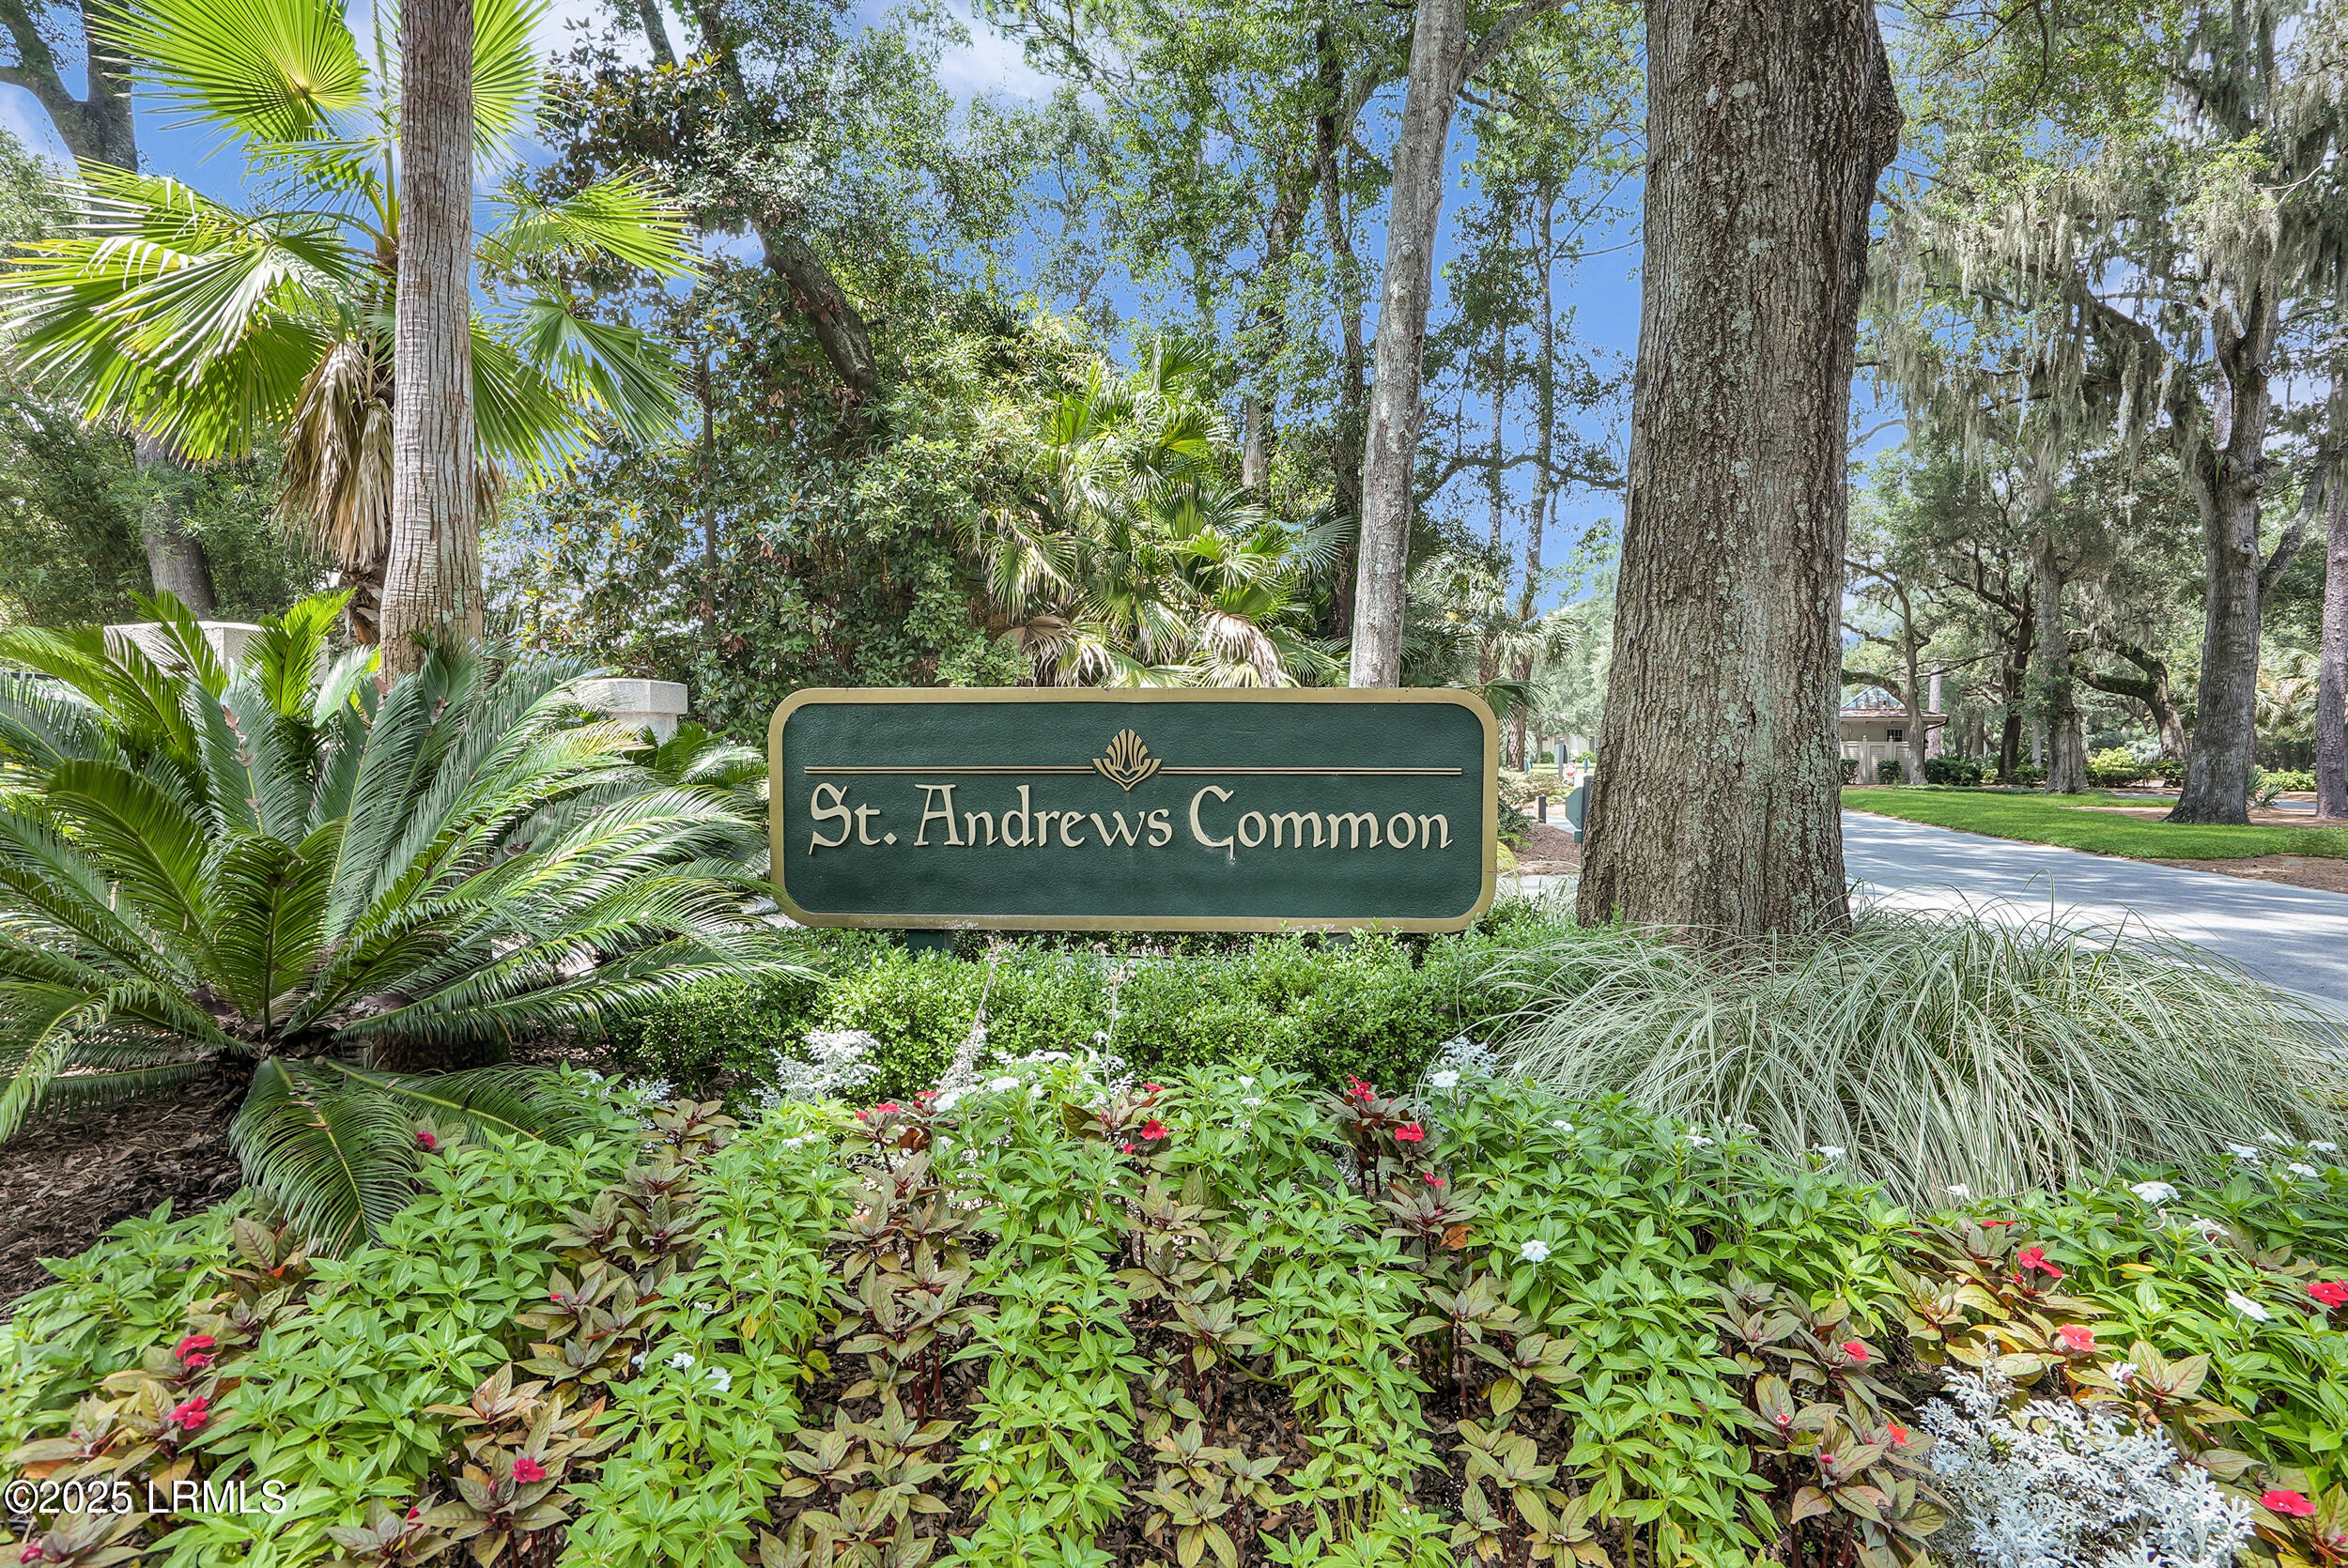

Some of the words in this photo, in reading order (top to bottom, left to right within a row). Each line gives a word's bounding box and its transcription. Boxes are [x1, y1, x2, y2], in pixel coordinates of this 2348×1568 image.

[809, 783, 898, 855] St.
[914, 783, 1172, 848] Andrews
[1189, 785, 1453, 860] Common
